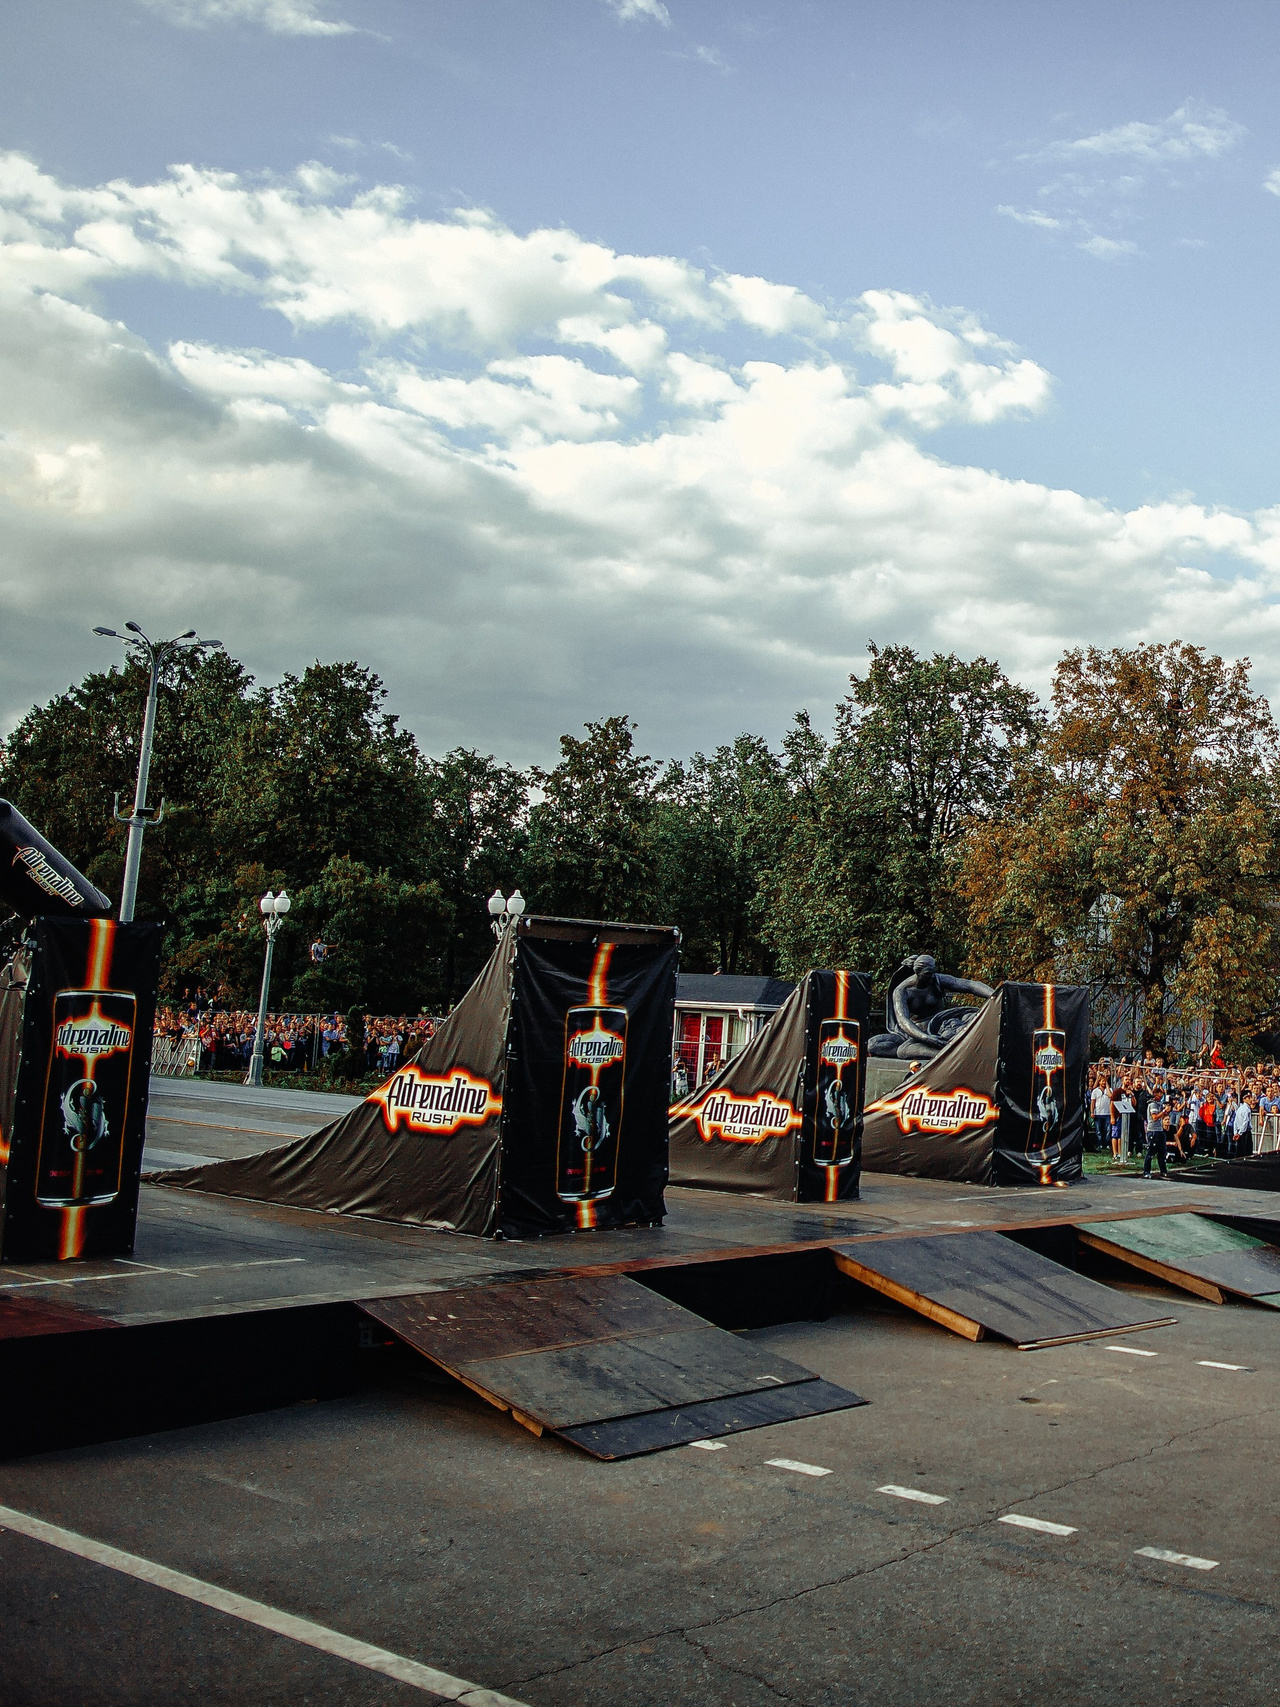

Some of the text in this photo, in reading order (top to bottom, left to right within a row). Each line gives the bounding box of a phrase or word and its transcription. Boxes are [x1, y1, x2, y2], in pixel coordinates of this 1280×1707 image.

[12, 846, 84, 907] Adrenaline
[26, 869, 55, 896] RUSH
[55, 1023, 131, 1052] Adrenaline
[70, 1046, 110, 1054] RUSH
[567, 1036, 624, 1060] Adrenaline
[386, 1073, 488, 1121] Adrenaline
[899, 1092, 987, 1125] Adrenaline
[411, 1111, 454, 1125] RUSH
[700, 1095, 789, 1132] Adrenaline
[921, 1118, 958, 1127] RUSH
[723, 1125, 761, 1136] RUSH
